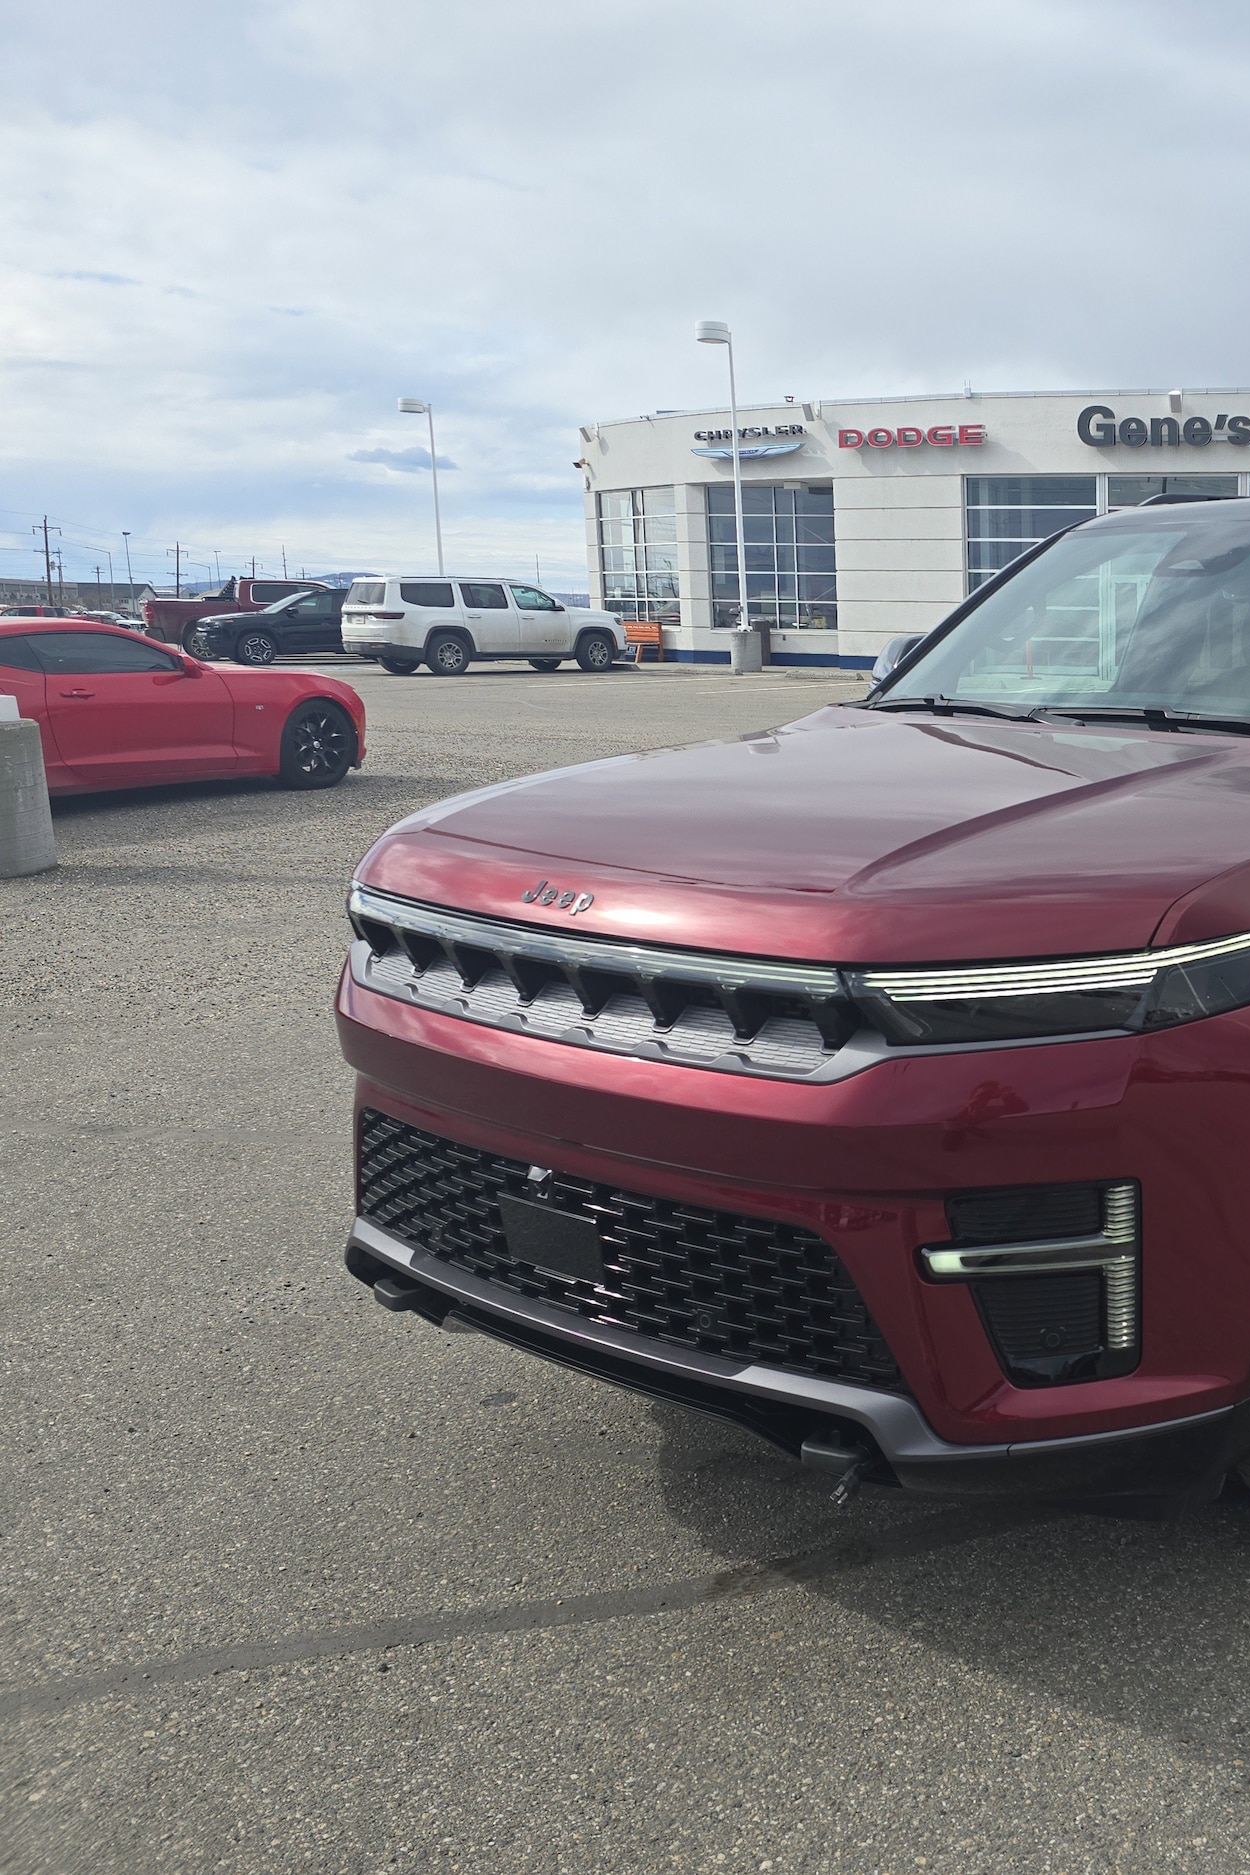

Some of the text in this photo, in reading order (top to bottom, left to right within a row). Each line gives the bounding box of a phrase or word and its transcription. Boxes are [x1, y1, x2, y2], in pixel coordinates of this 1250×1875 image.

[694, 424, 804, 441] CHRYSLER
[838, 424, 985, 449] DODGE
[522, 879, 595, 916] Jeep
